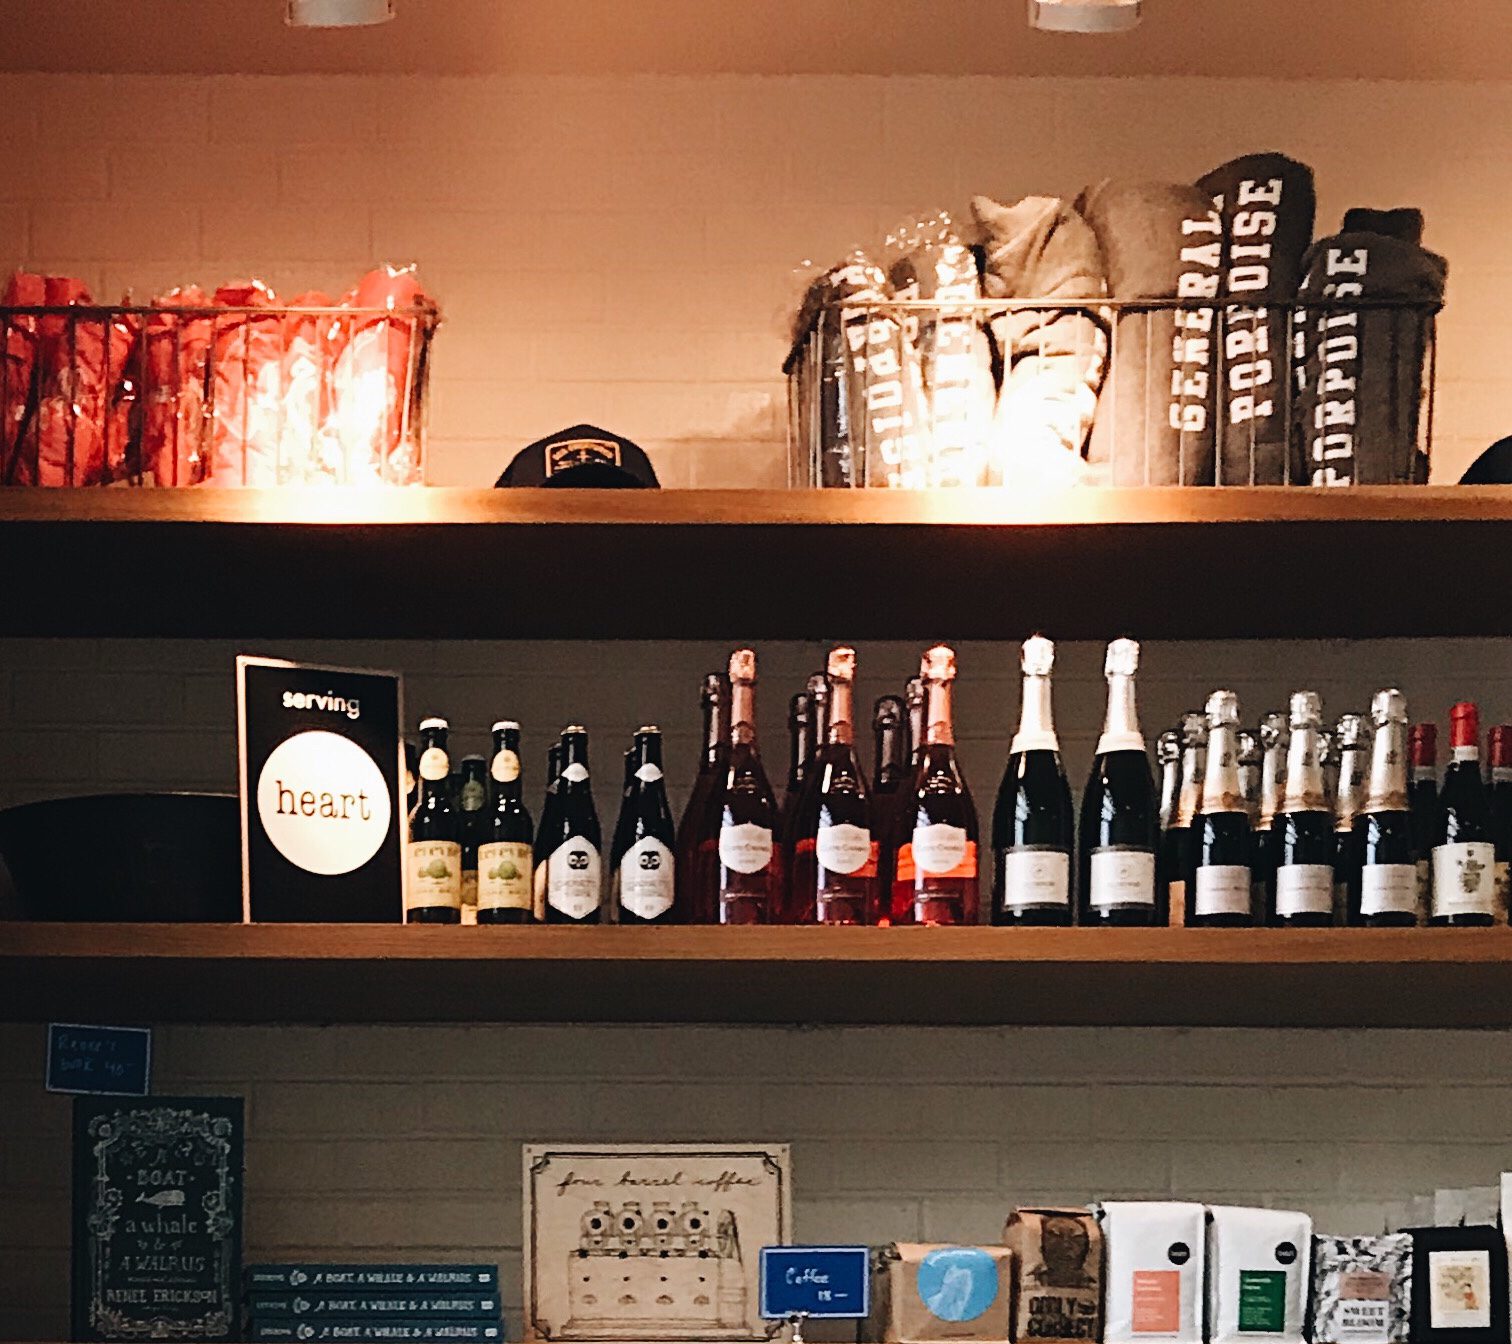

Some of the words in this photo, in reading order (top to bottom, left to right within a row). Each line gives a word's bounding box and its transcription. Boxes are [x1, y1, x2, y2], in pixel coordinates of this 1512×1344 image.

[1169, 194, 1224, 432] GENERAL
[282, 690, 360, 719] serving
[275, 780, 371, 821] heart
[141, 1213, 198, 1234] whale
[135, 1256, 206, 1272] WALRUS
